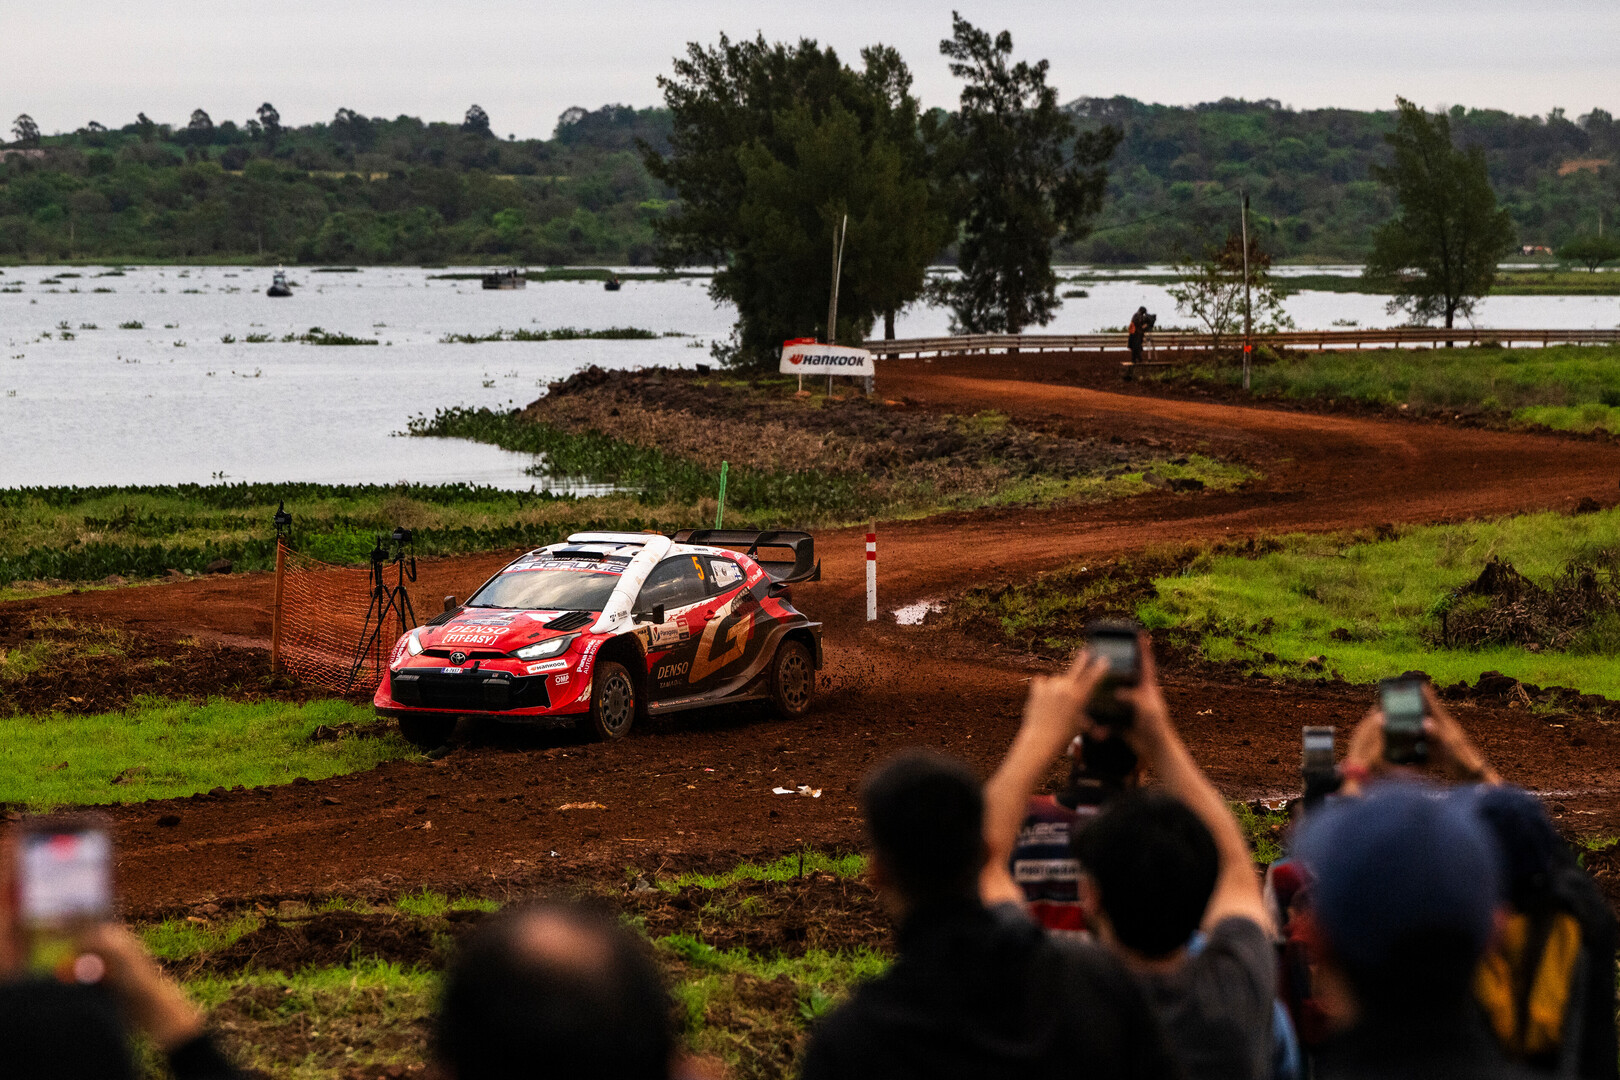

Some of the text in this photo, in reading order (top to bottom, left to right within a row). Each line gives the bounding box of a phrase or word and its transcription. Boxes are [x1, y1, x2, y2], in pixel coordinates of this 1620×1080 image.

[529, 561, 627, 573] FORUM8
[691, 556, 705, 580] 5
[447, 625, 510, 635] DENSO
[657, 661, 689, 680] DENSO
[555, 674, 570, 684] OMP
